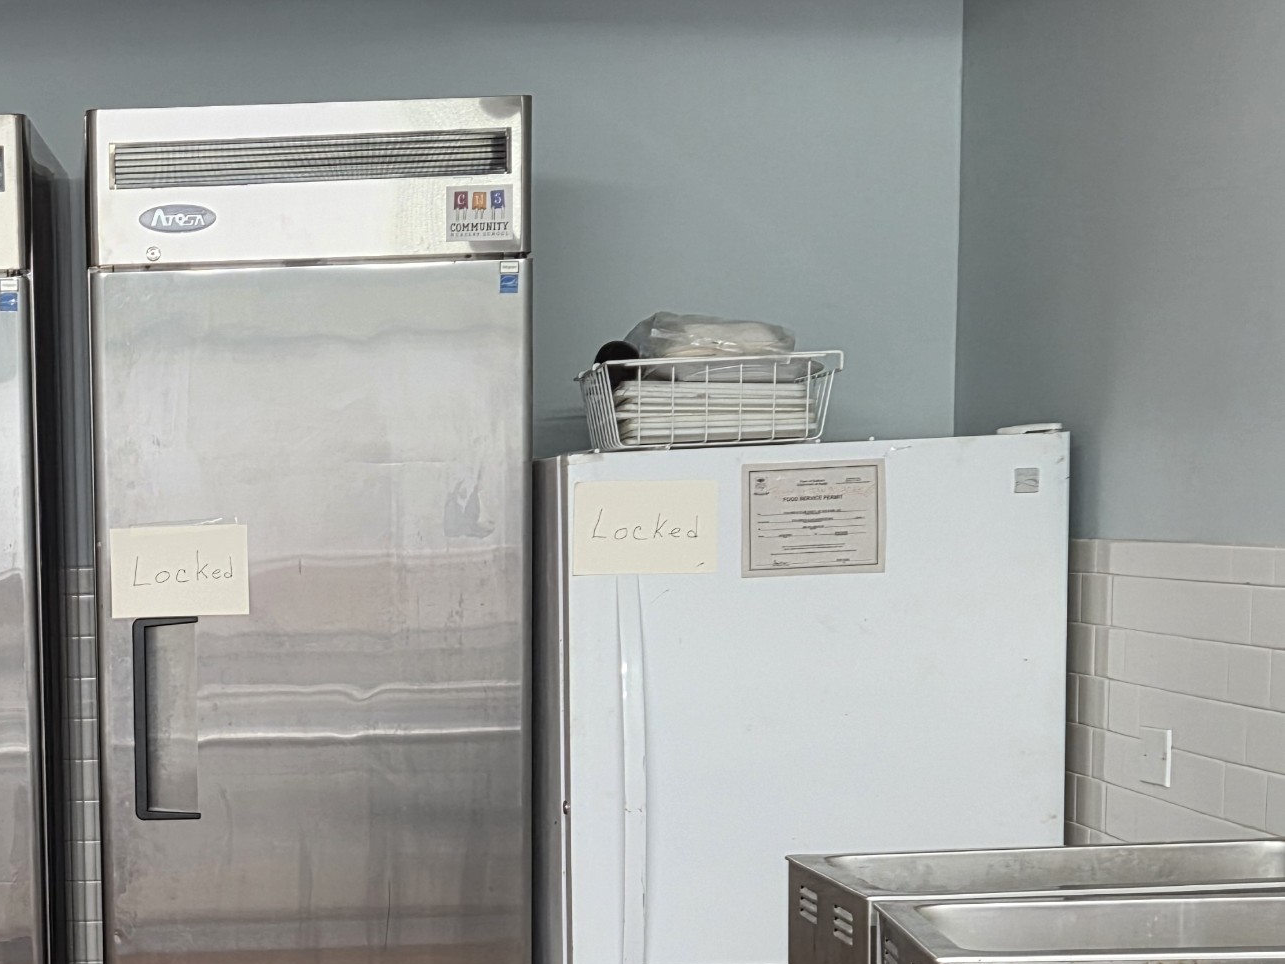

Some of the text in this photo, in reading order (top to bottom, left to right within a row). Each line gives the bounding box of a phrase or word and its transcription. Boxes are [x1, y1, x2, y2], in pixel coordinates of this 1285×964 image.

[449, 221, 510, 233] COMMUNITY
[591, 508, 699, 541] Locked
[132, 549, 233, 587] Locked
